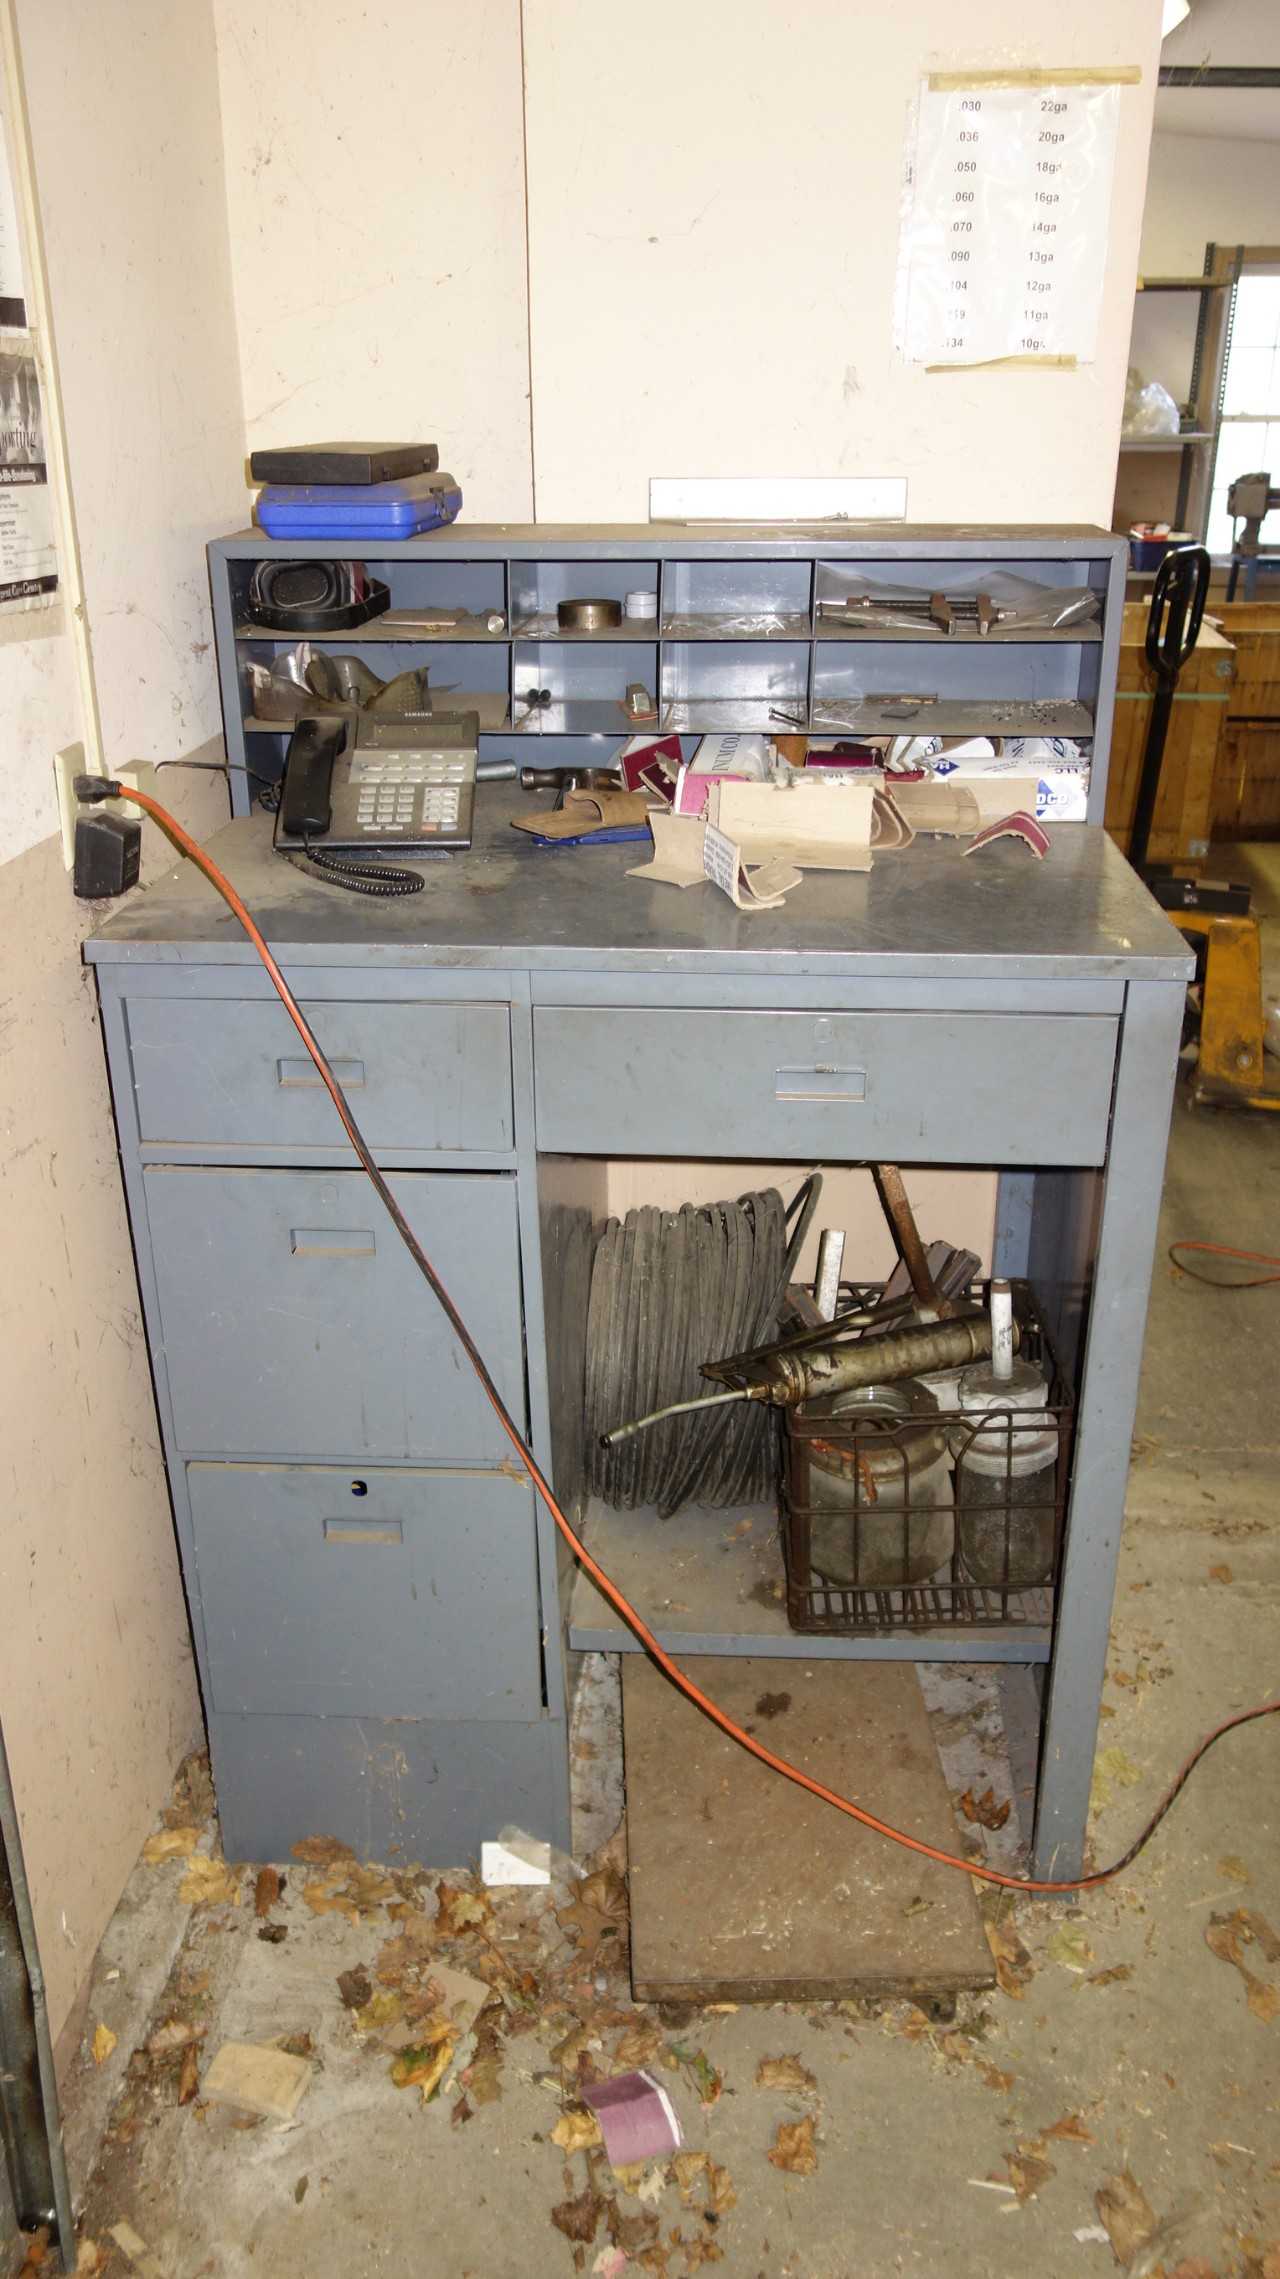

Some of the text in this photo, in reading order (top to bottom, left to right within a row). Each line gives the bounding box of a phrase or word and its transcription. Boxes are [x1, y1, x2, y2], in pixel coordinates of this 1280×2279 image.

[959, 101, 1067, 114] .030 22ga
[957, 131, 1065, 144] .036 20ga
[953, 162, 976, 172] .050
[952, 192, 1059, 204] .060 16ga
[950, 222, 1056, 234] .070 14ga
[1029, 252, 1053, 264] 13ga
[1026, 281, 1051, 293] 12ga
[1024, 310, 1048, 322] 11ga
